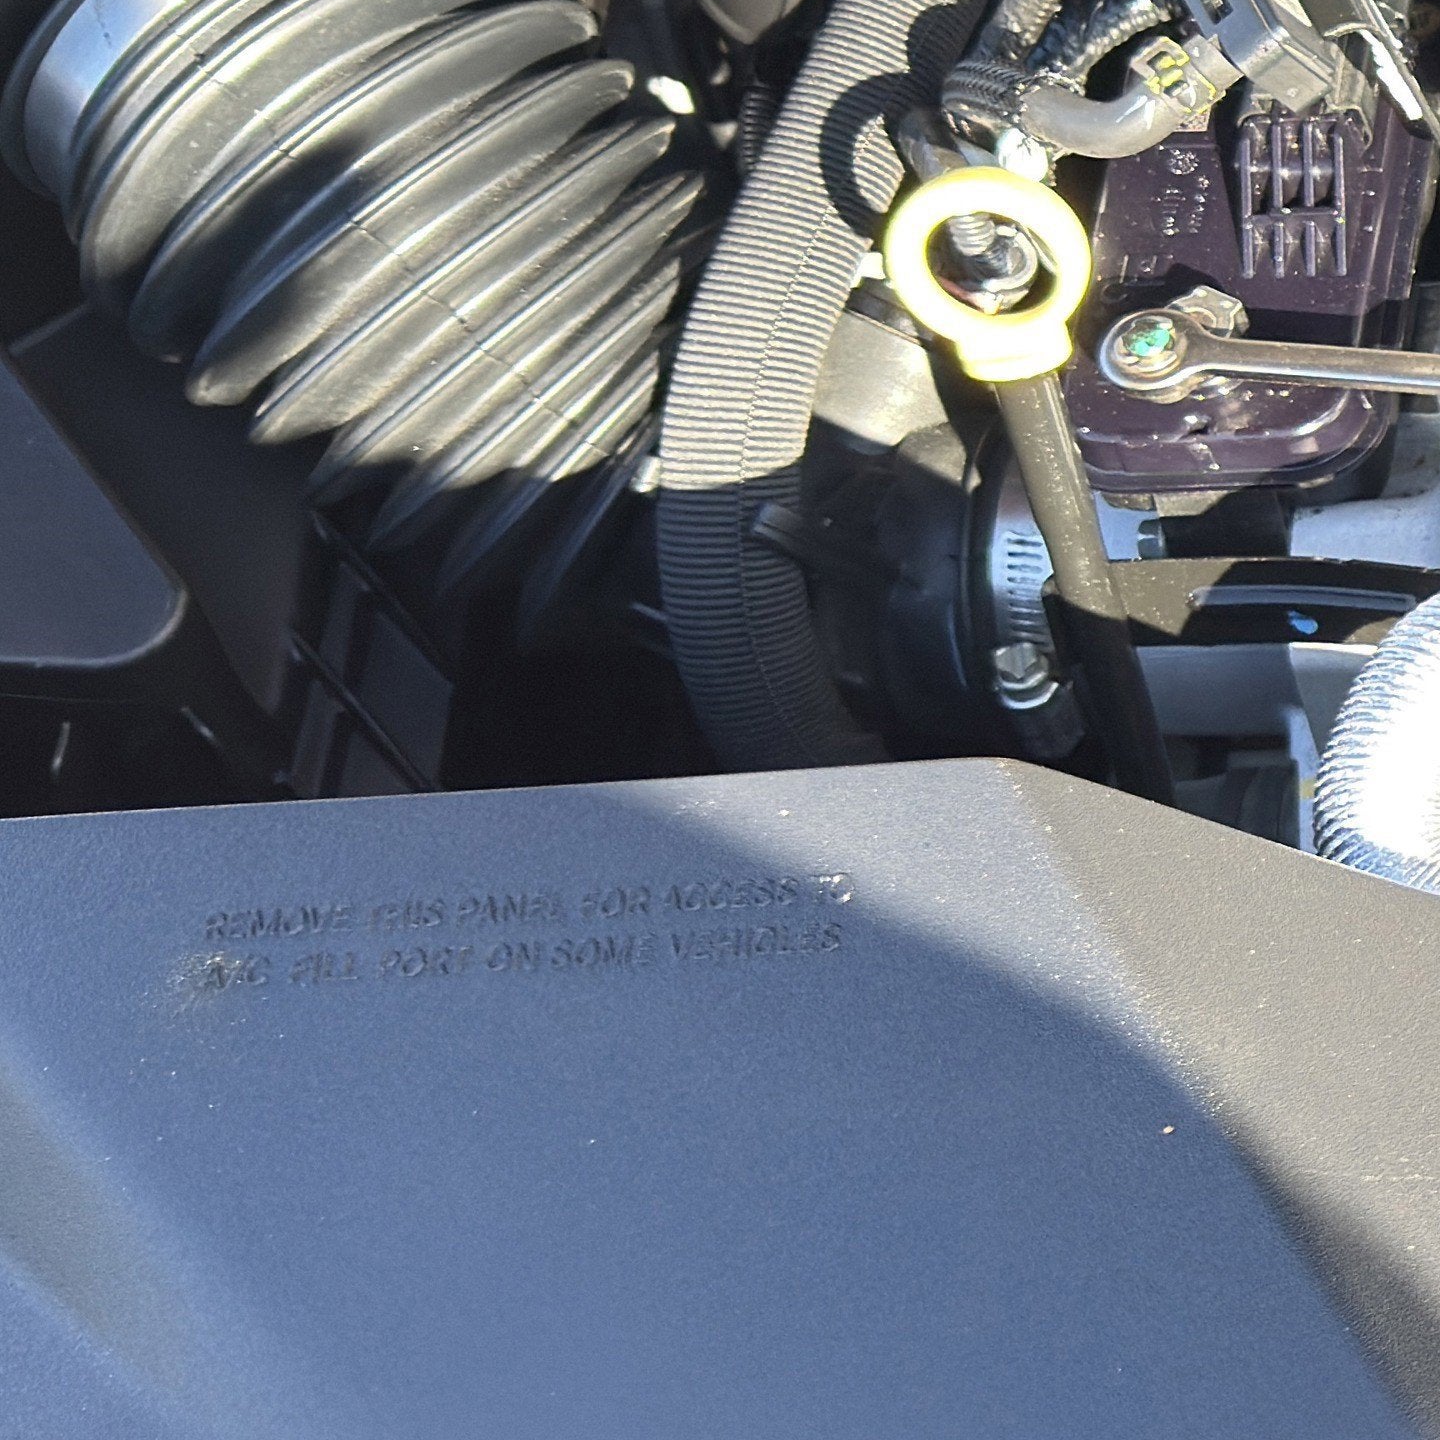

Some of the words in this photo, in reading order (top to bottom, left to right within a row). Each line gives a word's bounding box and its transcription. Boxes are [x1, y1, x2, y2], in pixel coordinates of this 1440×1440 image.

[205, 907, 351, 939] REMOVE
[366, 898, 444, 931] THIS
[457, 892, 562, 927] PANEL
[580, 885, 651, 918] FOR
[664, 877, 799, 912] ACCESS
[809, 871, 854, 905] TO
[378, 944, 473, 979] PORT
[486, 941, 542, 972] ON
[552, 933, 653, 967] SOME
[670, 922, 843, 960] VEHICLES
